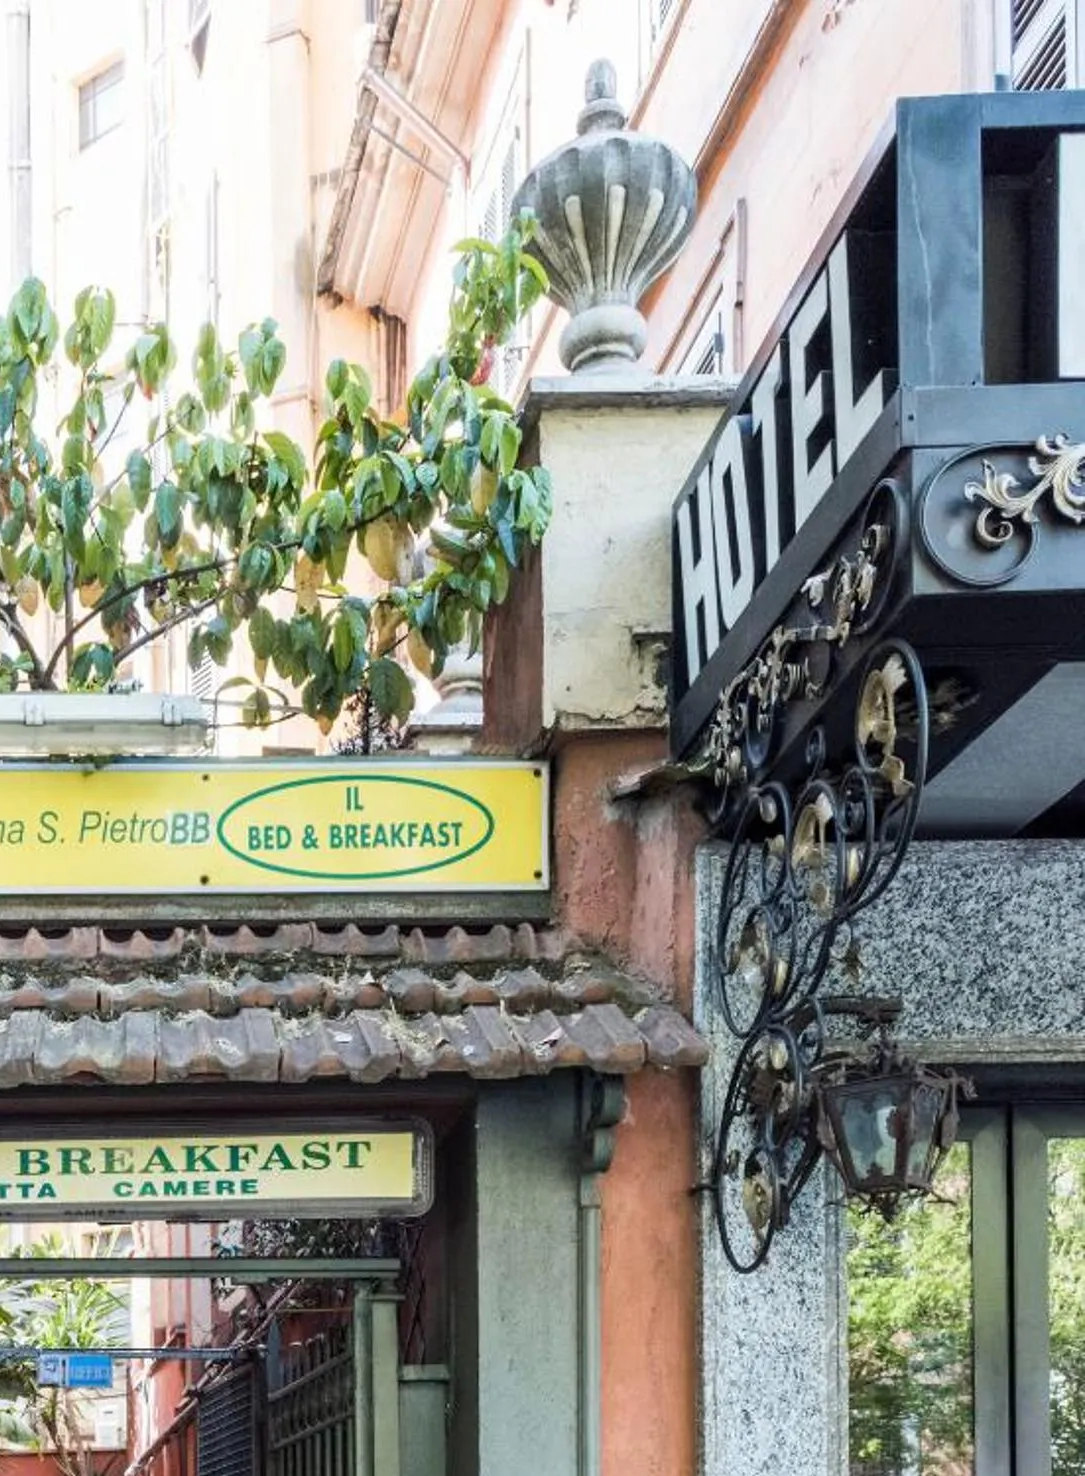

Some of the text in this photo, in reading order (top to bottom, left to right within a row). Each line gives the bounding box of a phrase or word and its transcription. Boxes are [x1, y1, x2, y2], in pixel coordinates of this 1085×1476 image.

[677, 229, 884, 686] HOTEL
[346, 787, 364, 811] IL
[38, 812, 65, 844] S.
[248, 822, 463, 851] BED & BREAKFAST
[15, 1141, 372, 1176] BREAKFAST
[114, 1178, 260, 1197] CAMERE
